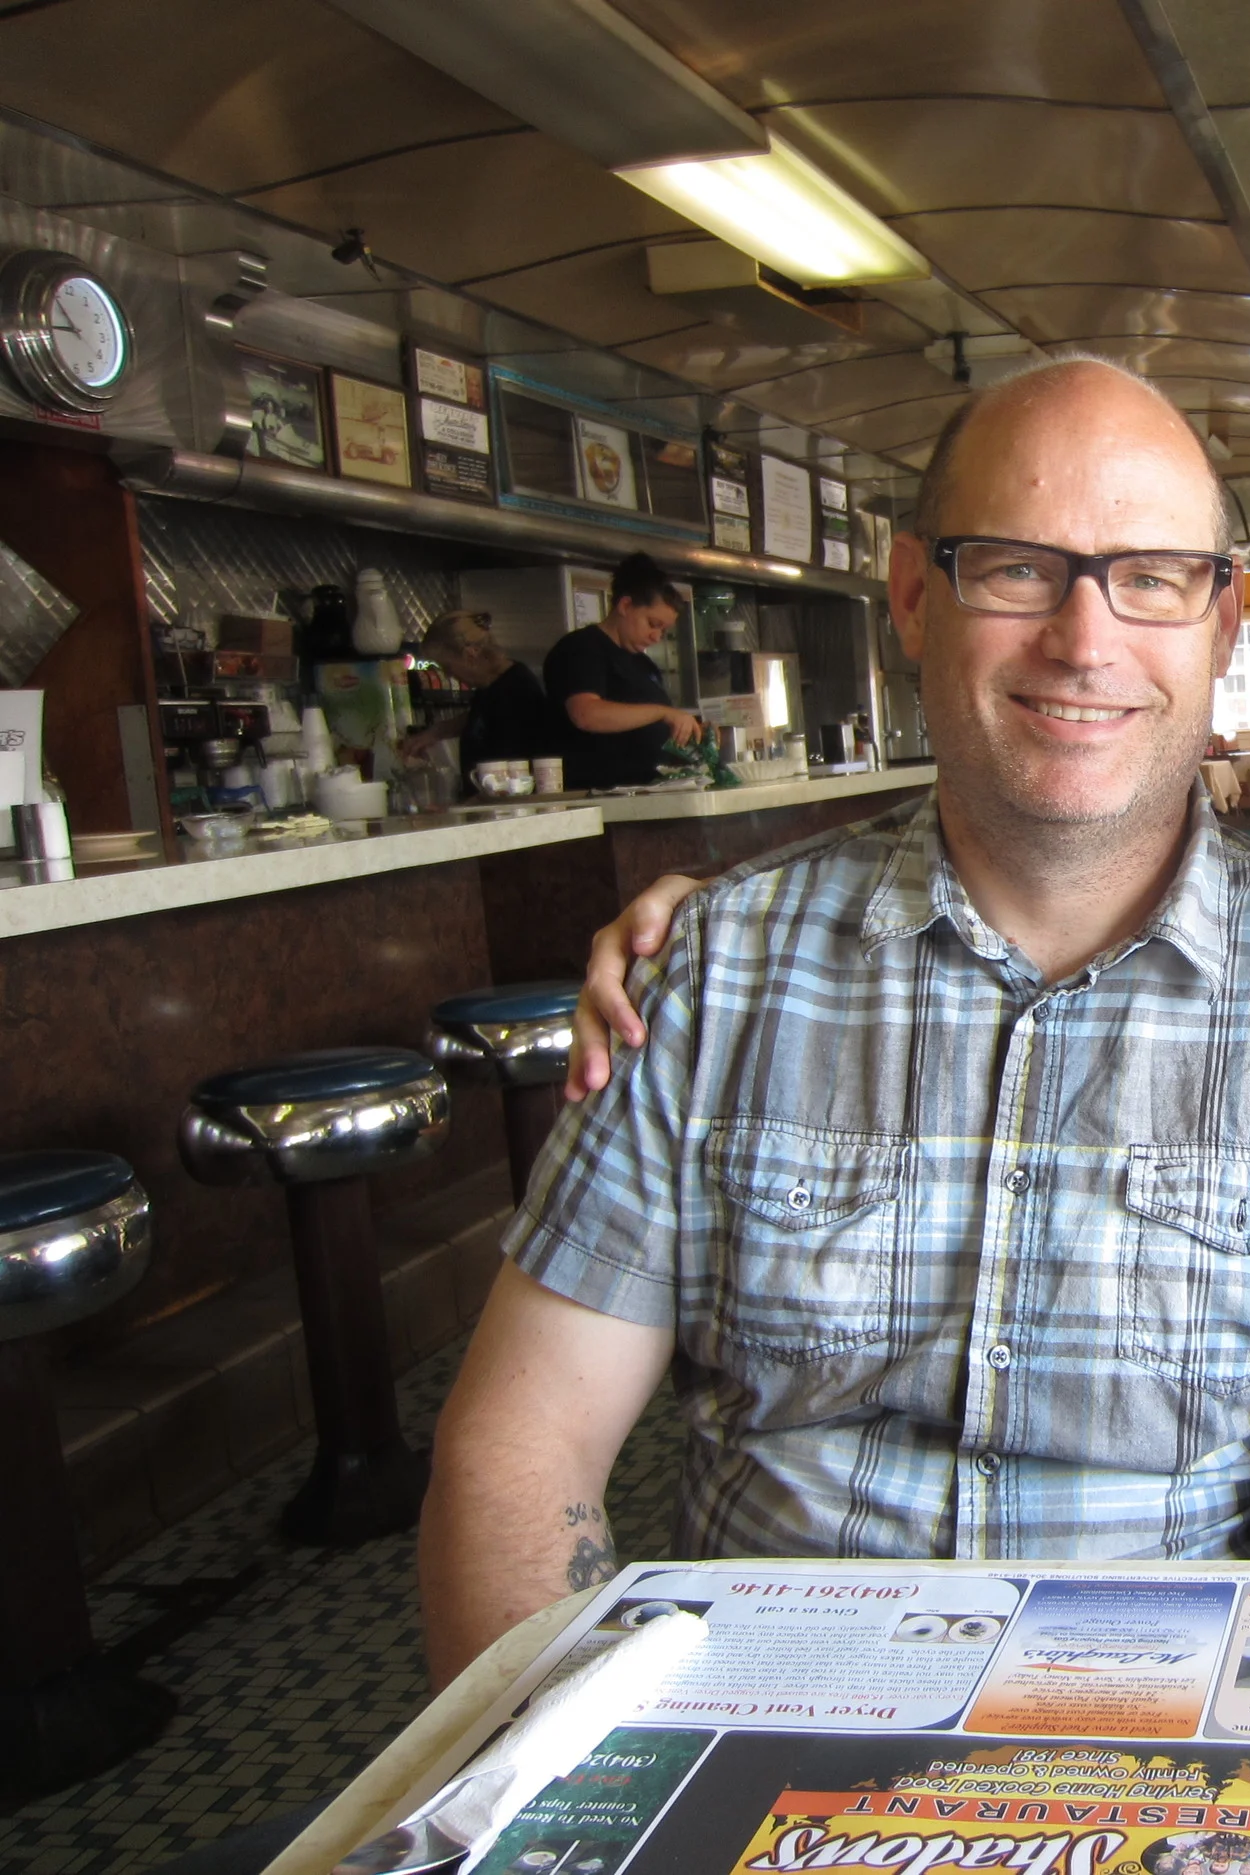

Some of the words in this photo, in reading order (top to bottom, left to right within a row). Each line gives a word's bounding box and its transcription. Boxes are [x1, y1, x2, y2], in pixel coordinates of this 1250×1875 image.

[728, 1582, 920, 1599] (304)261-4146
[755, 1606, 787, 1616] call
[789, 1606, 797, 1614] a
[801, 1606, 817, 1614] us
[820, 1606, 858, 1617] Give
[1124, 1618, 1159, 1626] Power
[1023, 1648, 1197, 1664] McLaughlin's
[654, 1698, 759, 1717] Cleaning
[762, 1703, 816, 1717] Vent
[825, 1703, 898, 1720] Dryer
[1000, 1722, 1059, 1732] Supplier?
[1062, 1724, 1089, 1734] Fuel
[1131, 1725, 1162, 1734] Need
[1011, 1749, 1058, 1763] 1981
[1062, 1750, 1121, 1764] Since
[928, 1759, 1029, 1777] Operated
[1031, 1764, 1048, 1778] &
[1051, 1765, 1129, 1781] Owned
[1131, 1765, 1201, 1782] Family
[892, 1776, 959, 1792] Food
[961, 1778, 1051, 1796] Cooked
[1054, 1781, 1126, 1797] Home
[1128, 1781, 1216, 1800] Serving
[541, 1799, 572, 1811] Tops
[576, 1801, 637, 1812] Counter
[843, 1795, 1250, 1828] RESTAURANT
[557, 1814, 574, 1824] To
[580, 1814, 617, 1825] Need
[621, 1816, 643, 1826] No
[747, 1826, 1126, 1875] Shadows
